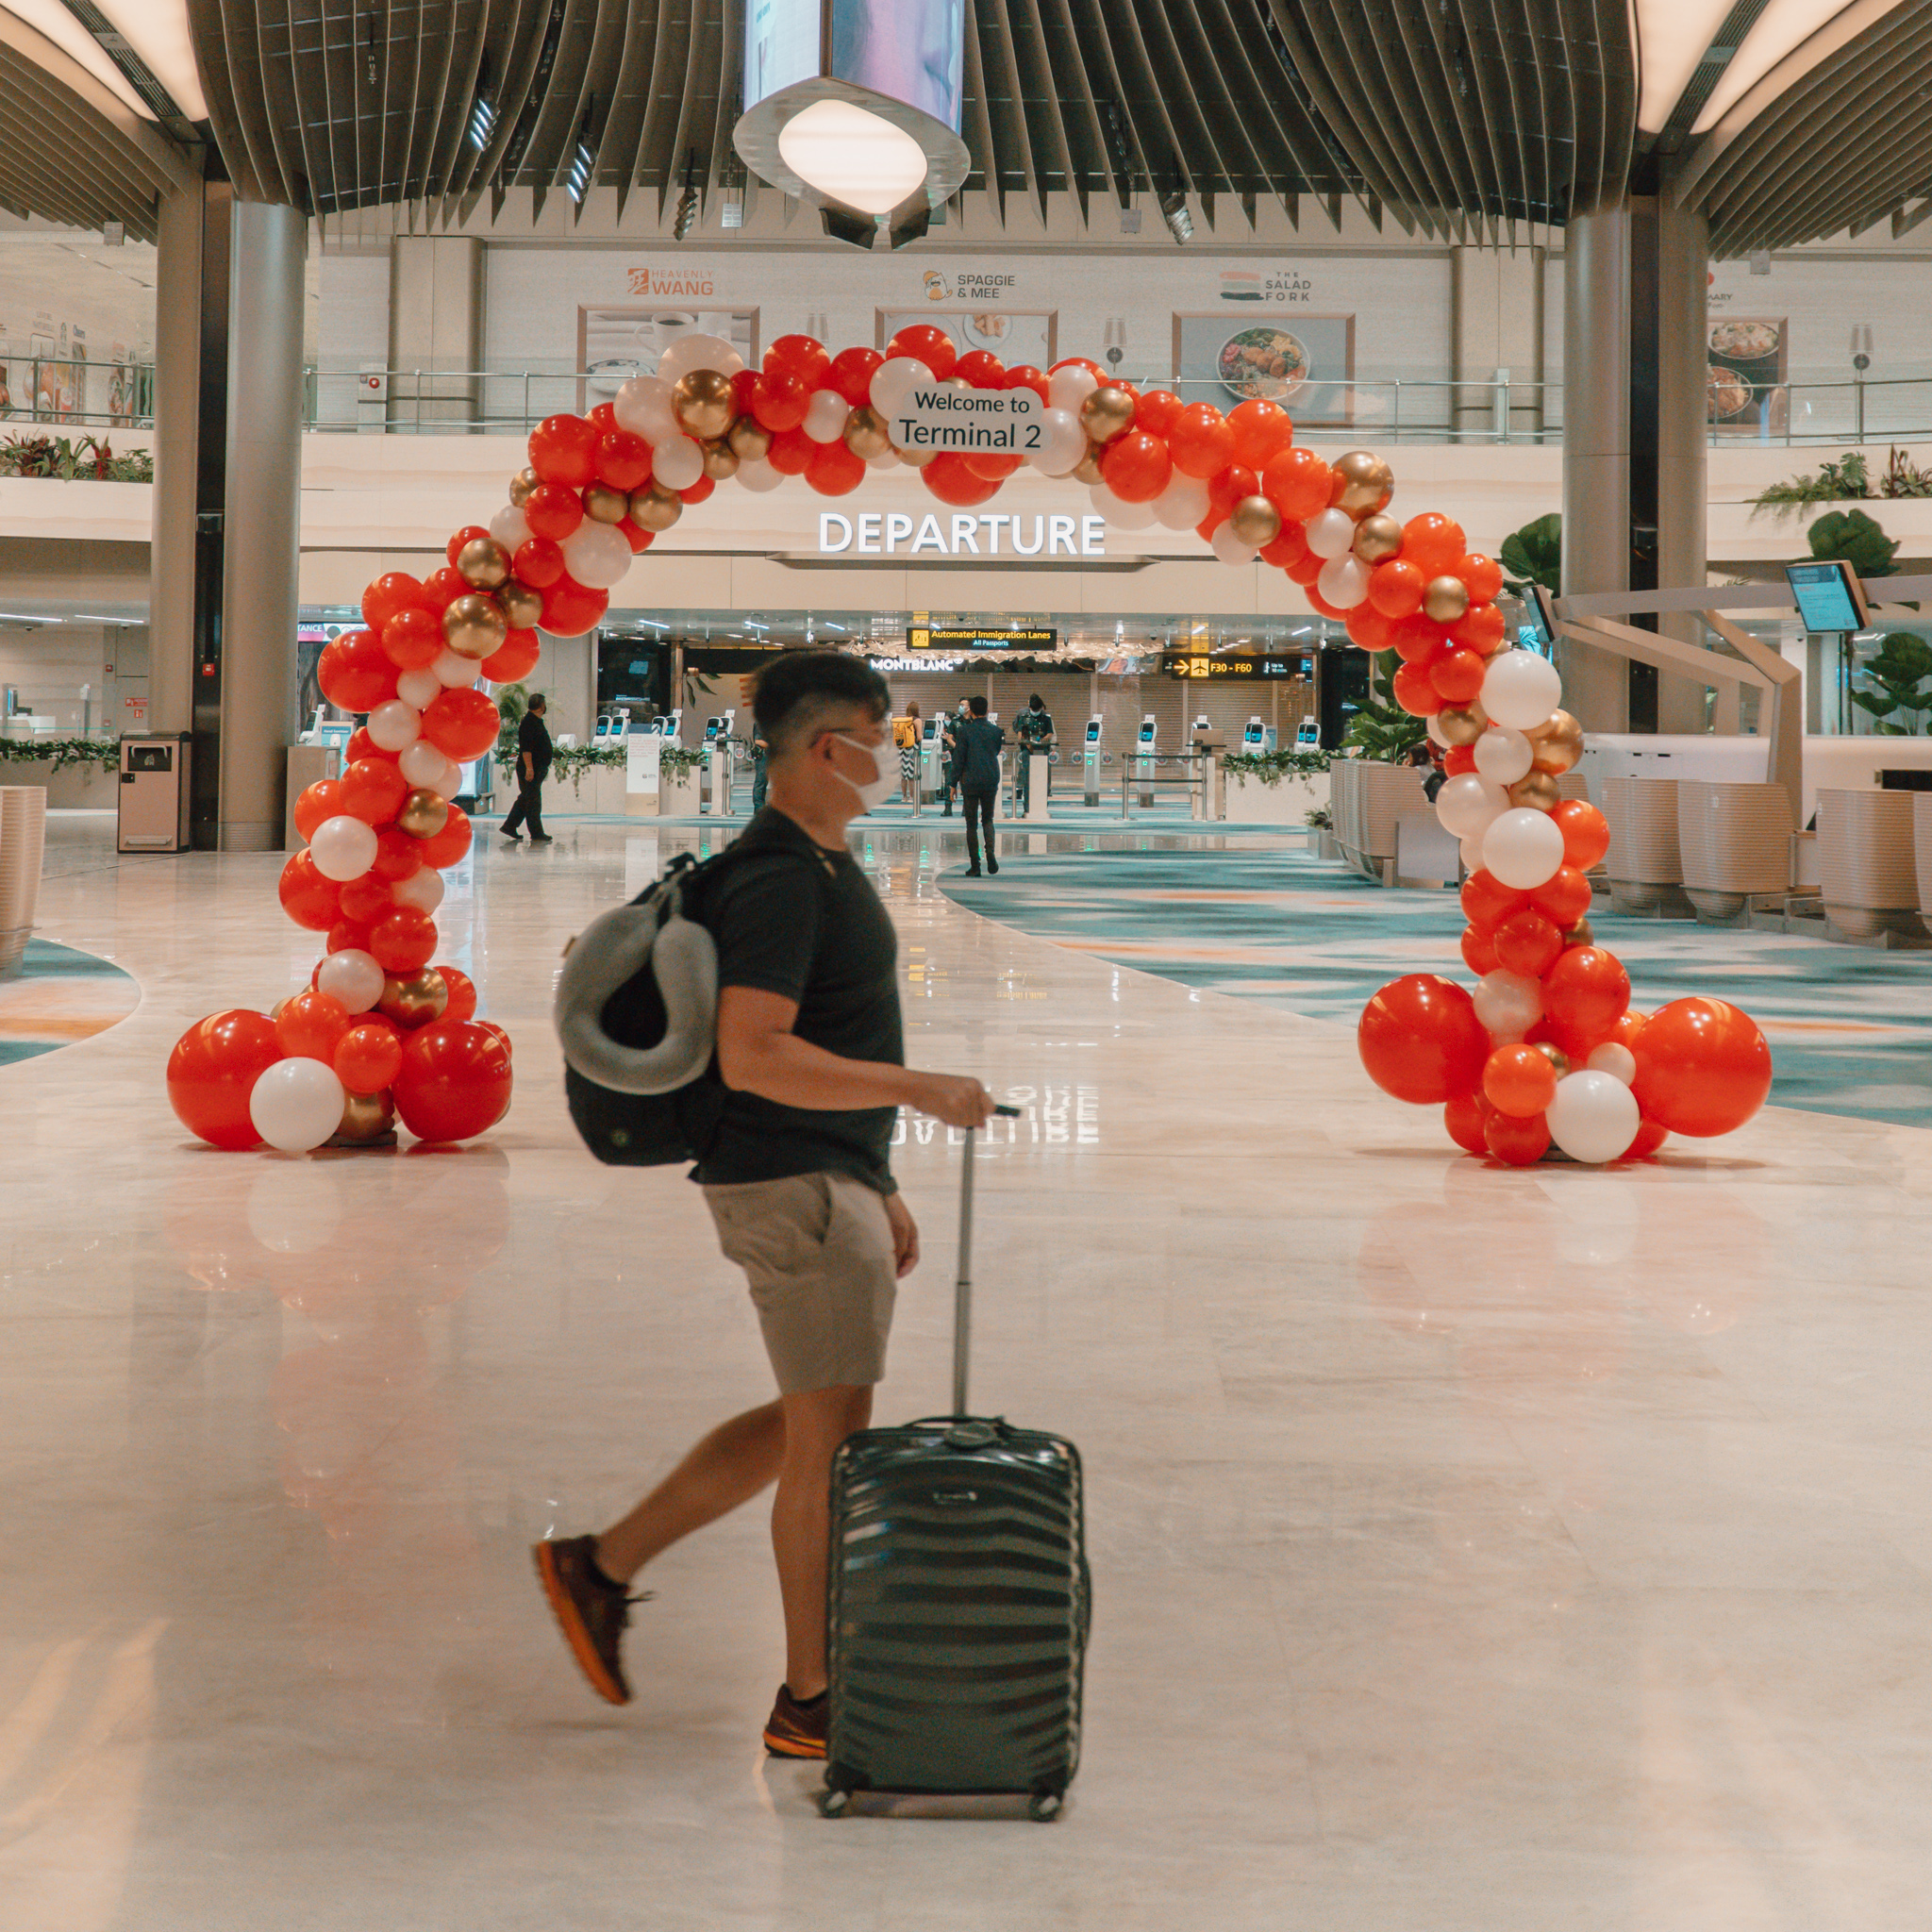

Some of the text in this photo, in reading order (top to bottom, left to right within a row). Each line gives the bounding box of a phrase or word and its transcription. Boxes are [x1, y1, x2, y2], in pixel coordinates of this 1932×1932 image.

[651, 270, 714, 278] HEAVENLY
[958, 275, 1015, 286] SPAGGIE
[1265, 280, 1311, 290] SALAD
[652, 281, 713, 295] WANG
[958, 287, 1000, 298] & MEE
[1265, 291, 1309, 301] FORK
[914, 391, 1030, 413] Welcome to
[898, 419, 1041, 448] Terminal 2
[818, 511, 1106, 555] DEPARTURE
[931, 630, 1051, 640] Automated Immigration Lanes
[870, 658, 954, 671] MONTBLANC
[1210, 663, 1227, 673] F30
[1235, 663, 1253, 673] F60
